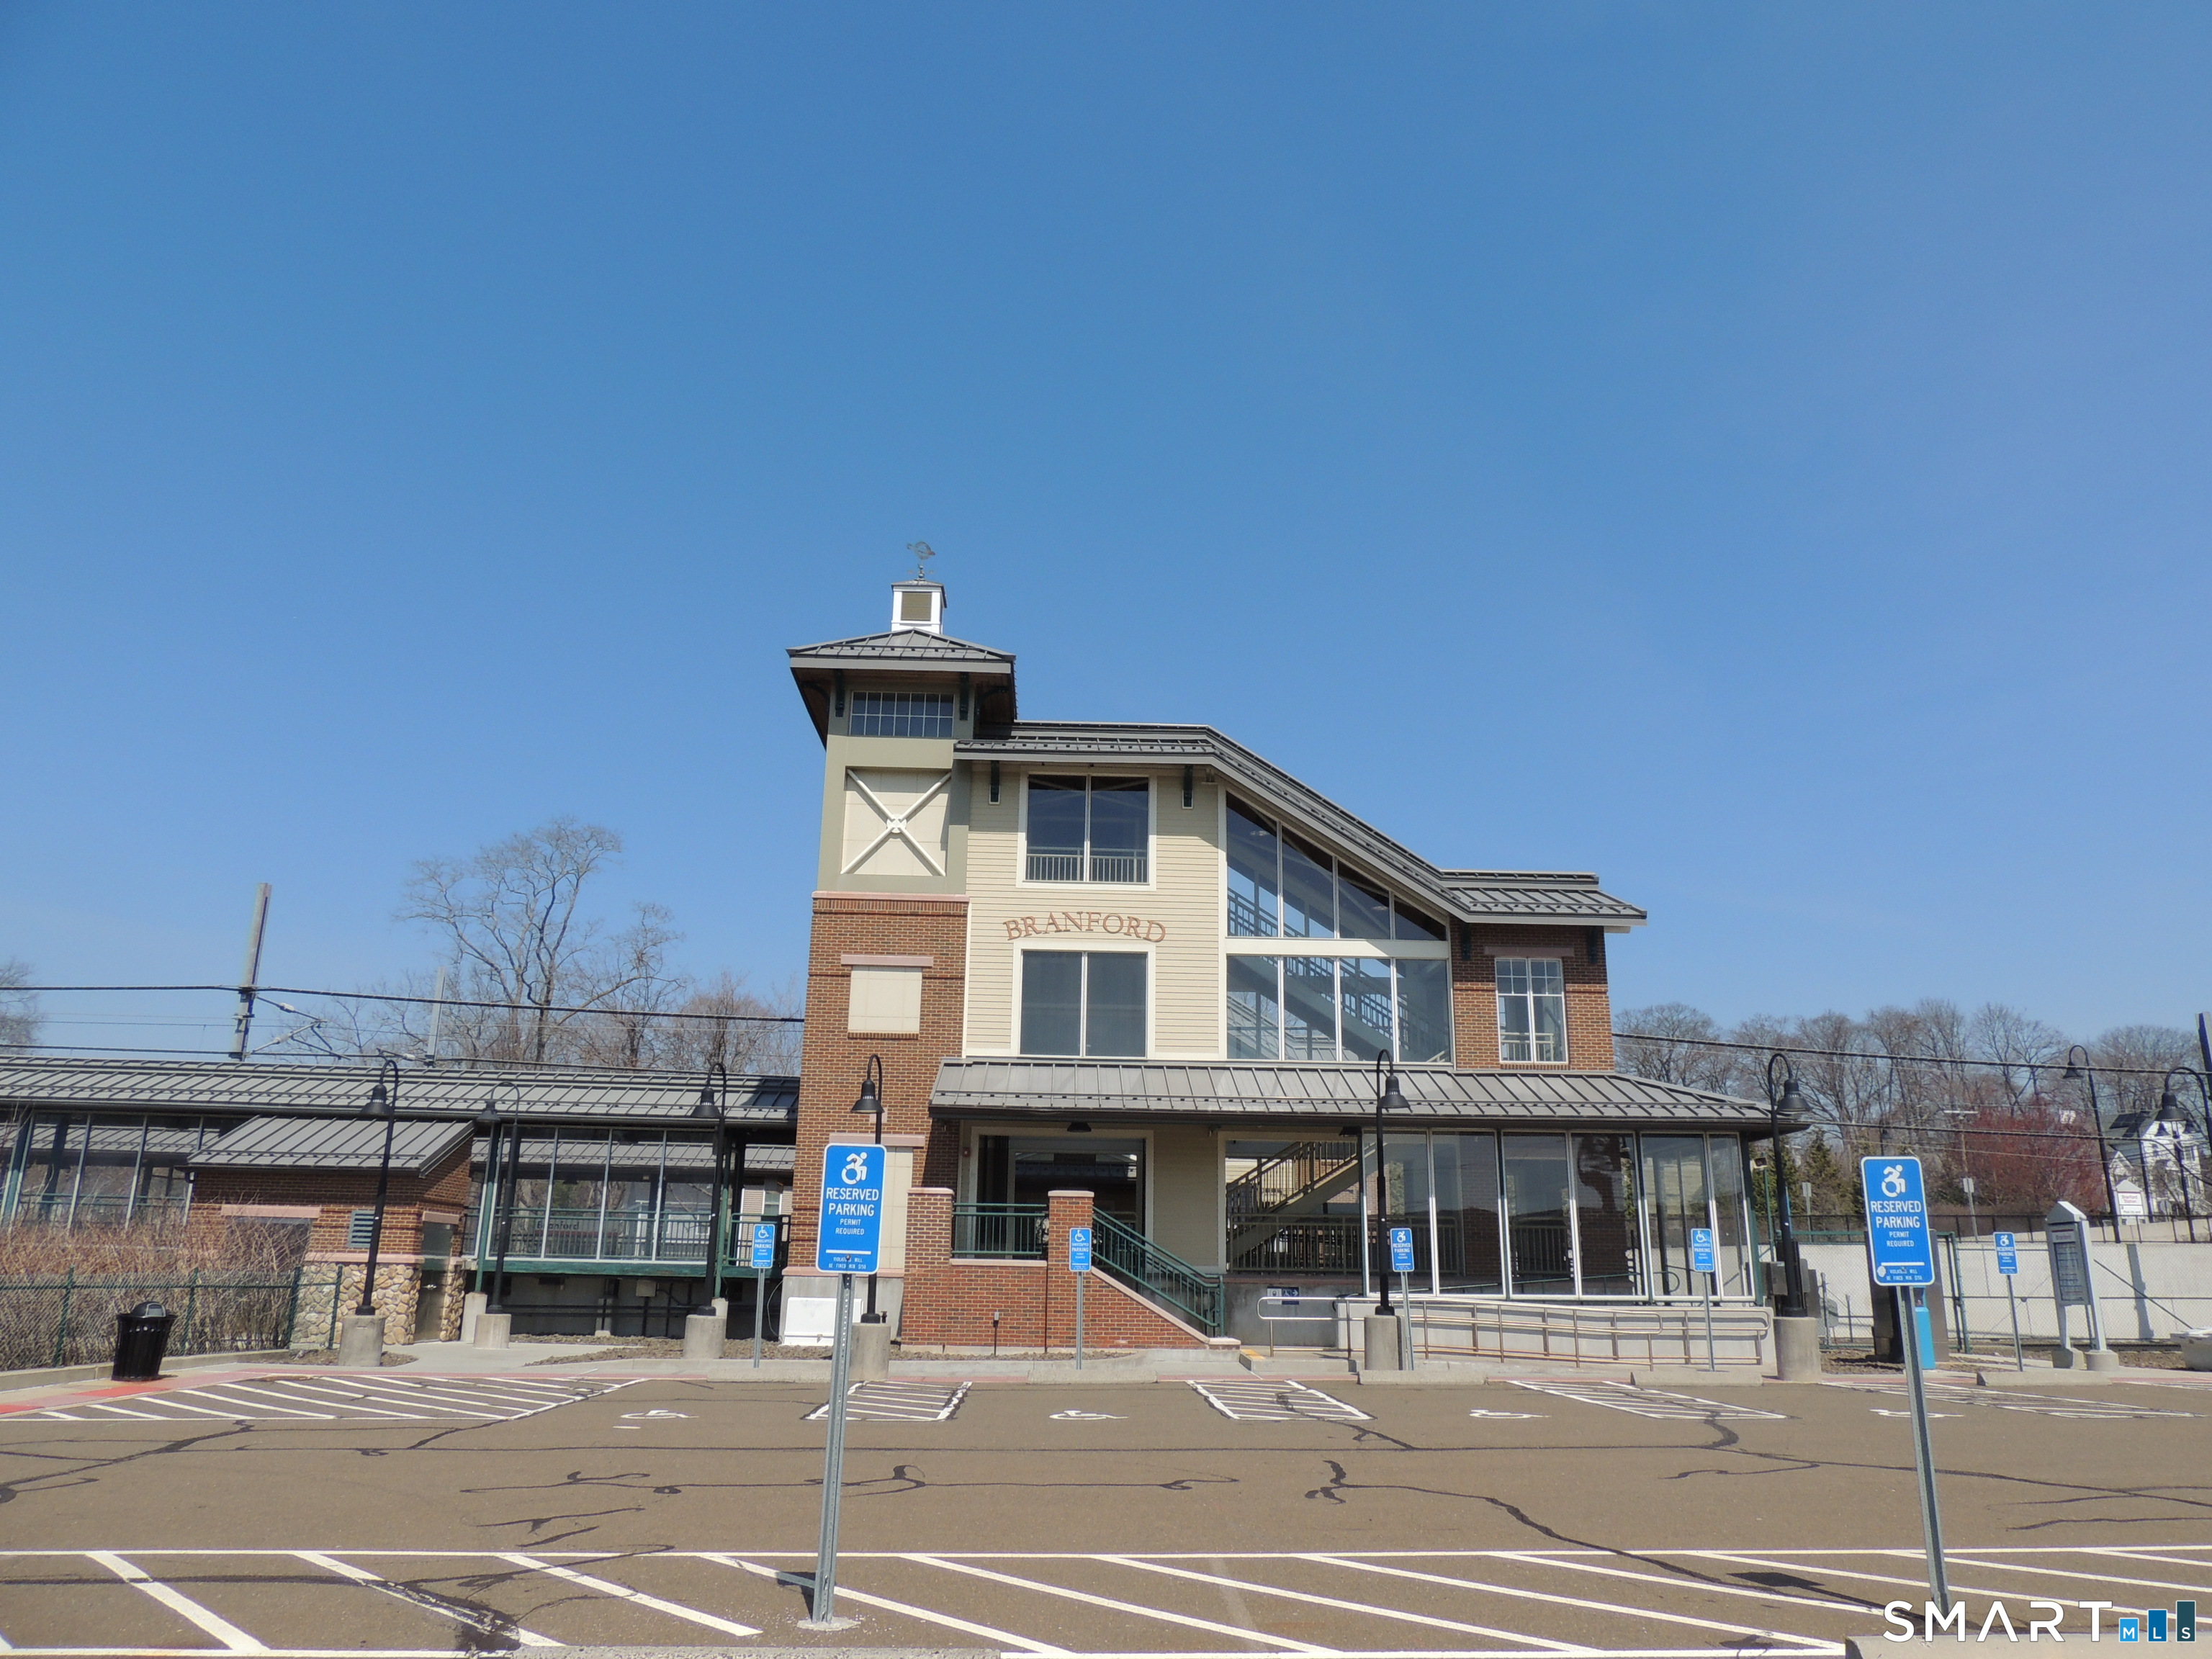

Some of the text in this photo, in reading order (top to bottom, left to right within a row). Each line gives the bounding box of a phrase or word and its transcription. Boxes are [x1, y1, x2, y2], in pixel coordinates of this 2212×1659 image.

[1002, 911, 1166, 943] BRANFORD
[826, 1187, 879, 1201] RESERVED
[828, 1202, 874, 1217] PARKING
[1870, 1201, 1922, 1213] RESERVED
[537, 1221, 580, 1230] Banford
[1876, 1216, 1920, 1228] PARKING
